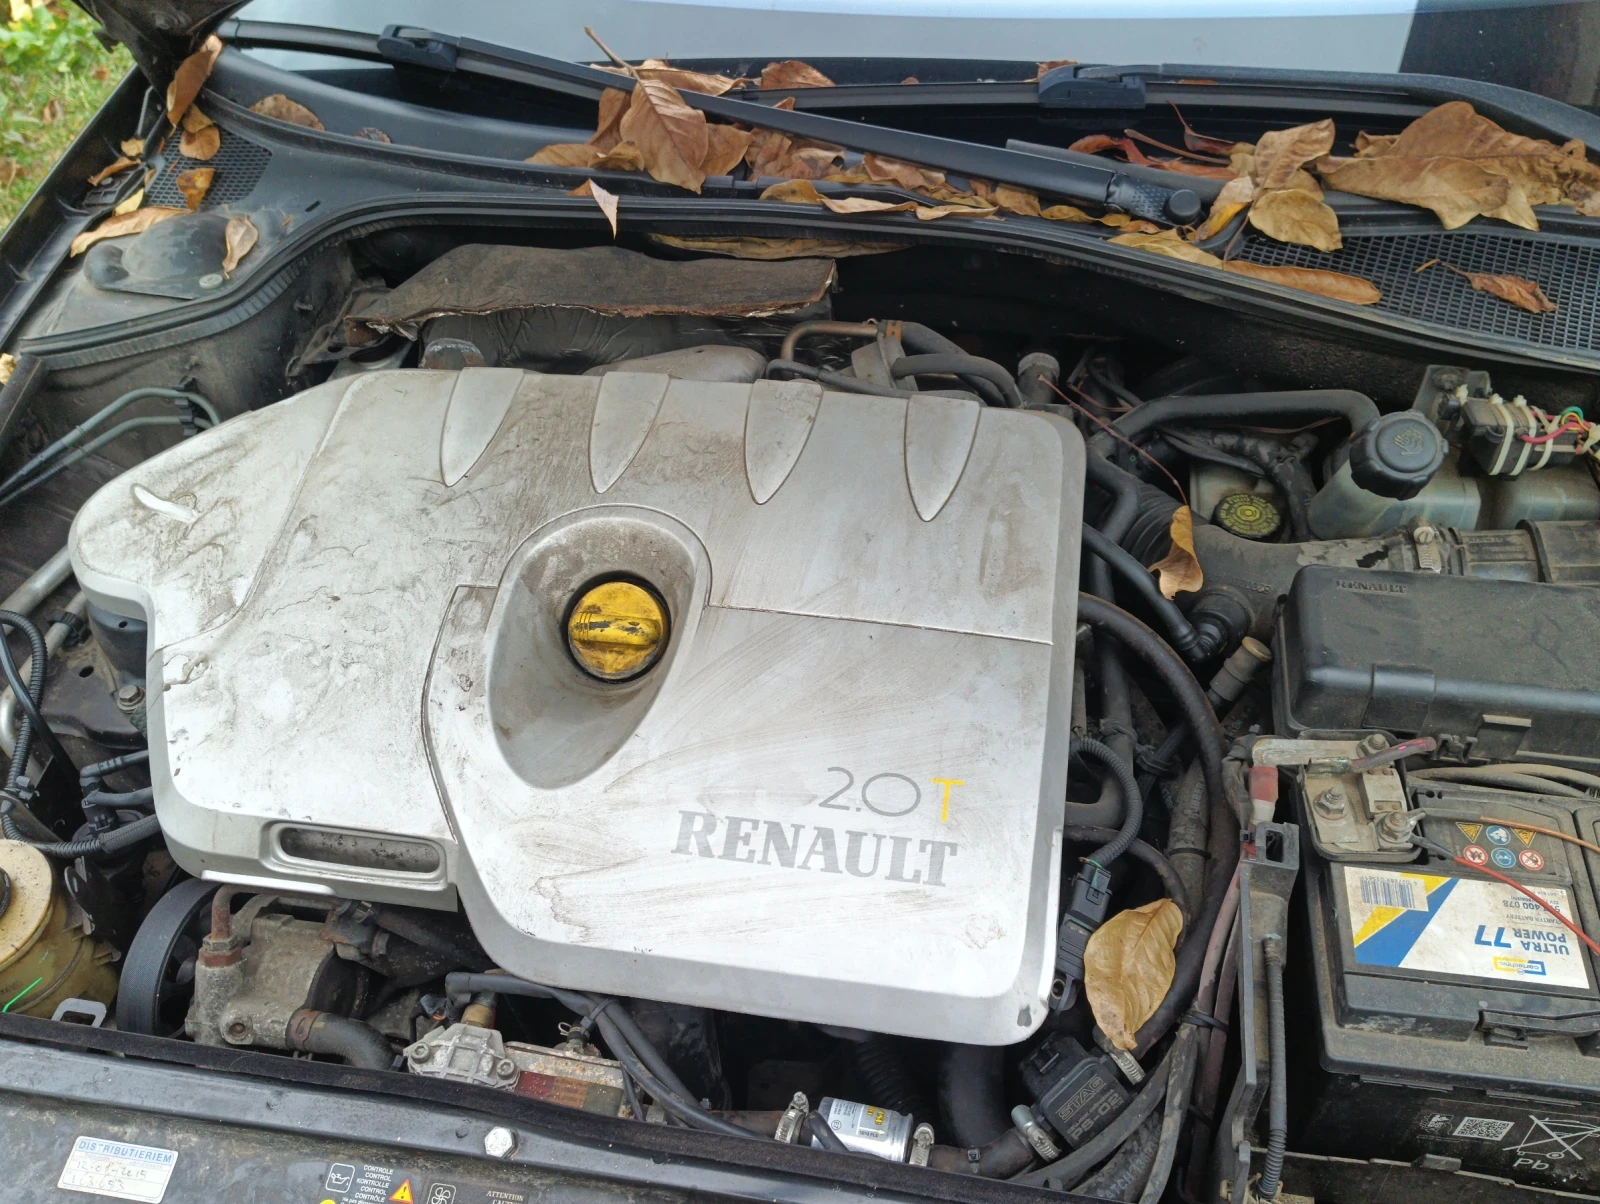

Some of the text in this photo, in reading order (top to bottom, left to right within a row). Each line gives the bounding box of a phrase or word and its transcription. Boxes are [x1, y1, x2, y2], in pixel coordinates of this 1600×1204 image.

[1336, 580, 1408, 594] RENAULT
[670, 809, 958, 887] RENAULT
[1502, 899, 1521, 908] 078
[1522, 902, 1541, 911] 400
[1505, 913, 1534, 922] BATTERY
[1474, 924, 1567, 949] POWER 77
[1520, 940, 1570, 956] ULTRA
[1499, 961, 1540, 970] cartechnic
[1058, 1076, 1104, 1121] STAG
[1070, 1092, 1119, 1141] PS-02
[1512, 1157, 1550, 1170] Pb
[356, 1177, 390, 1189] KONTROLLE
[364, 1172, 392, 1182] CONTROL
[360, 1185, 387, 1196] CONTROL
[486, 1190, 525, 1202] ATTENTION
